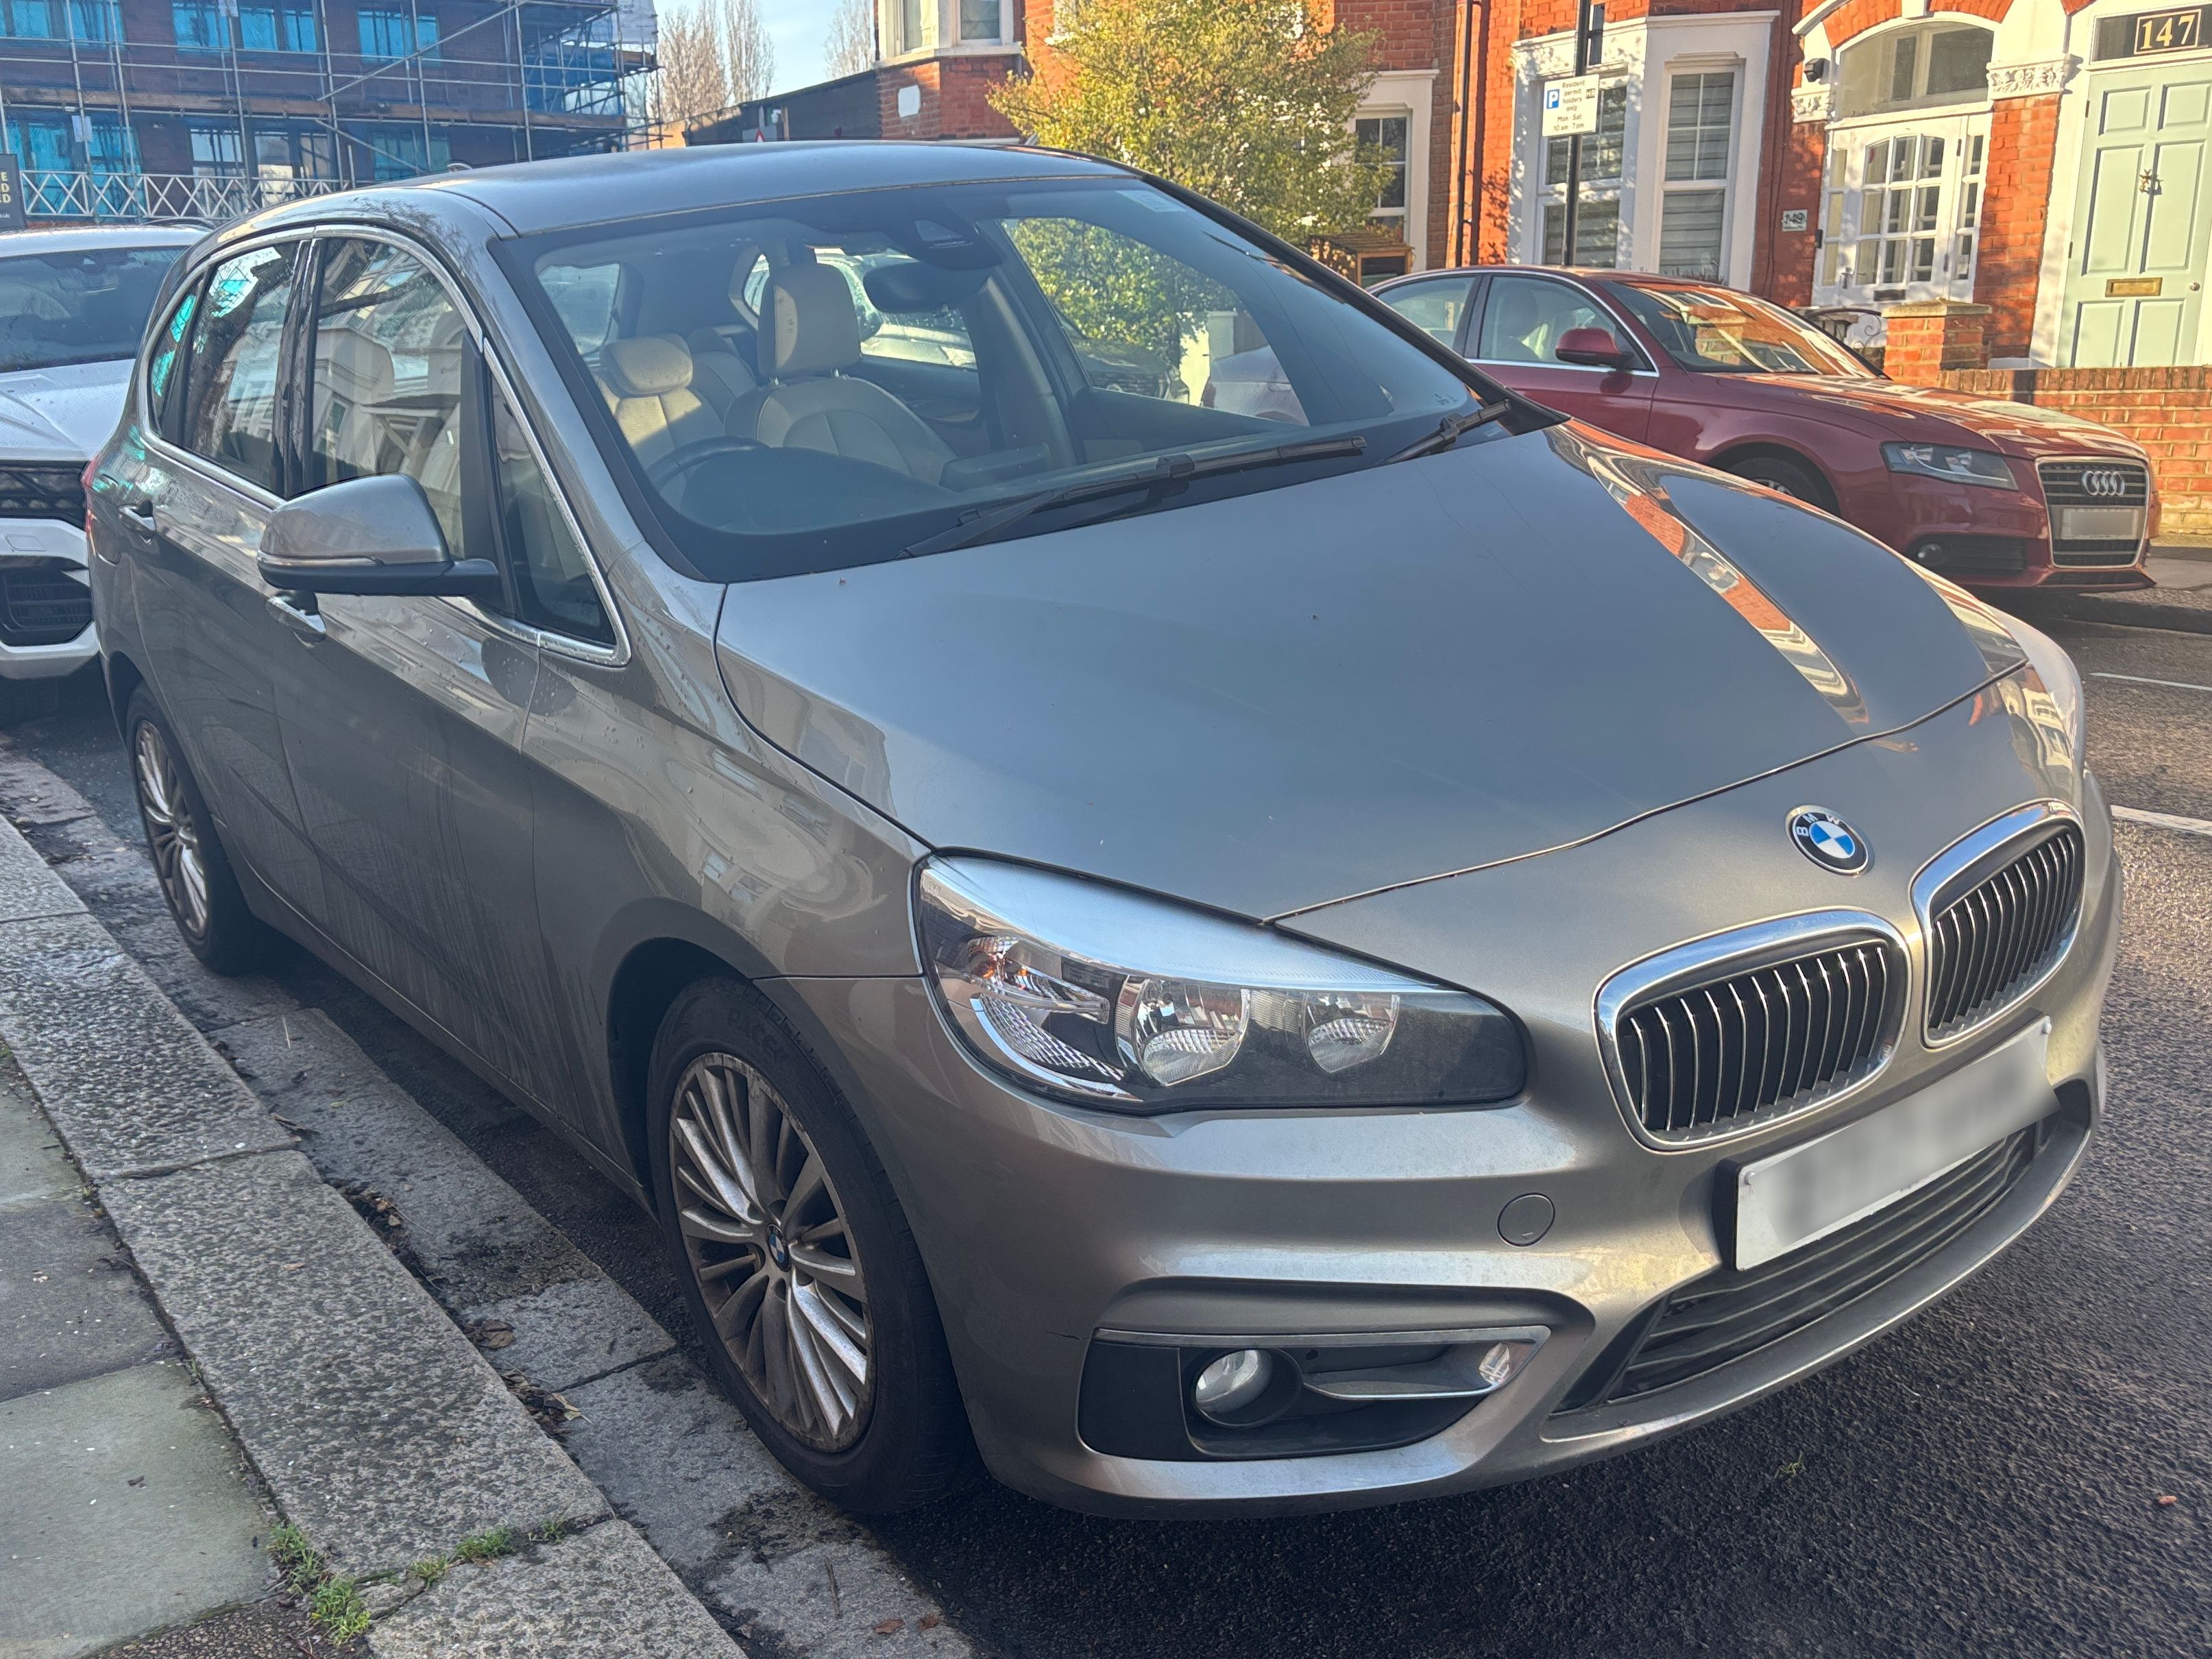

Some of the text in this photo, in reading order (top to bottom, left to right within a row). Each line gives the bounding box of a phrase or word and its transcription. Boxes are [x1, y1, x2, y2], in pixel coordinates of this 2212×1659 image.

[2139, 14, 2196, 49] 147
[1548, 90, 1559, 108] P
[1564, 88, 1582, 97] permit
[1796, 813, 1840, 837] BMW
